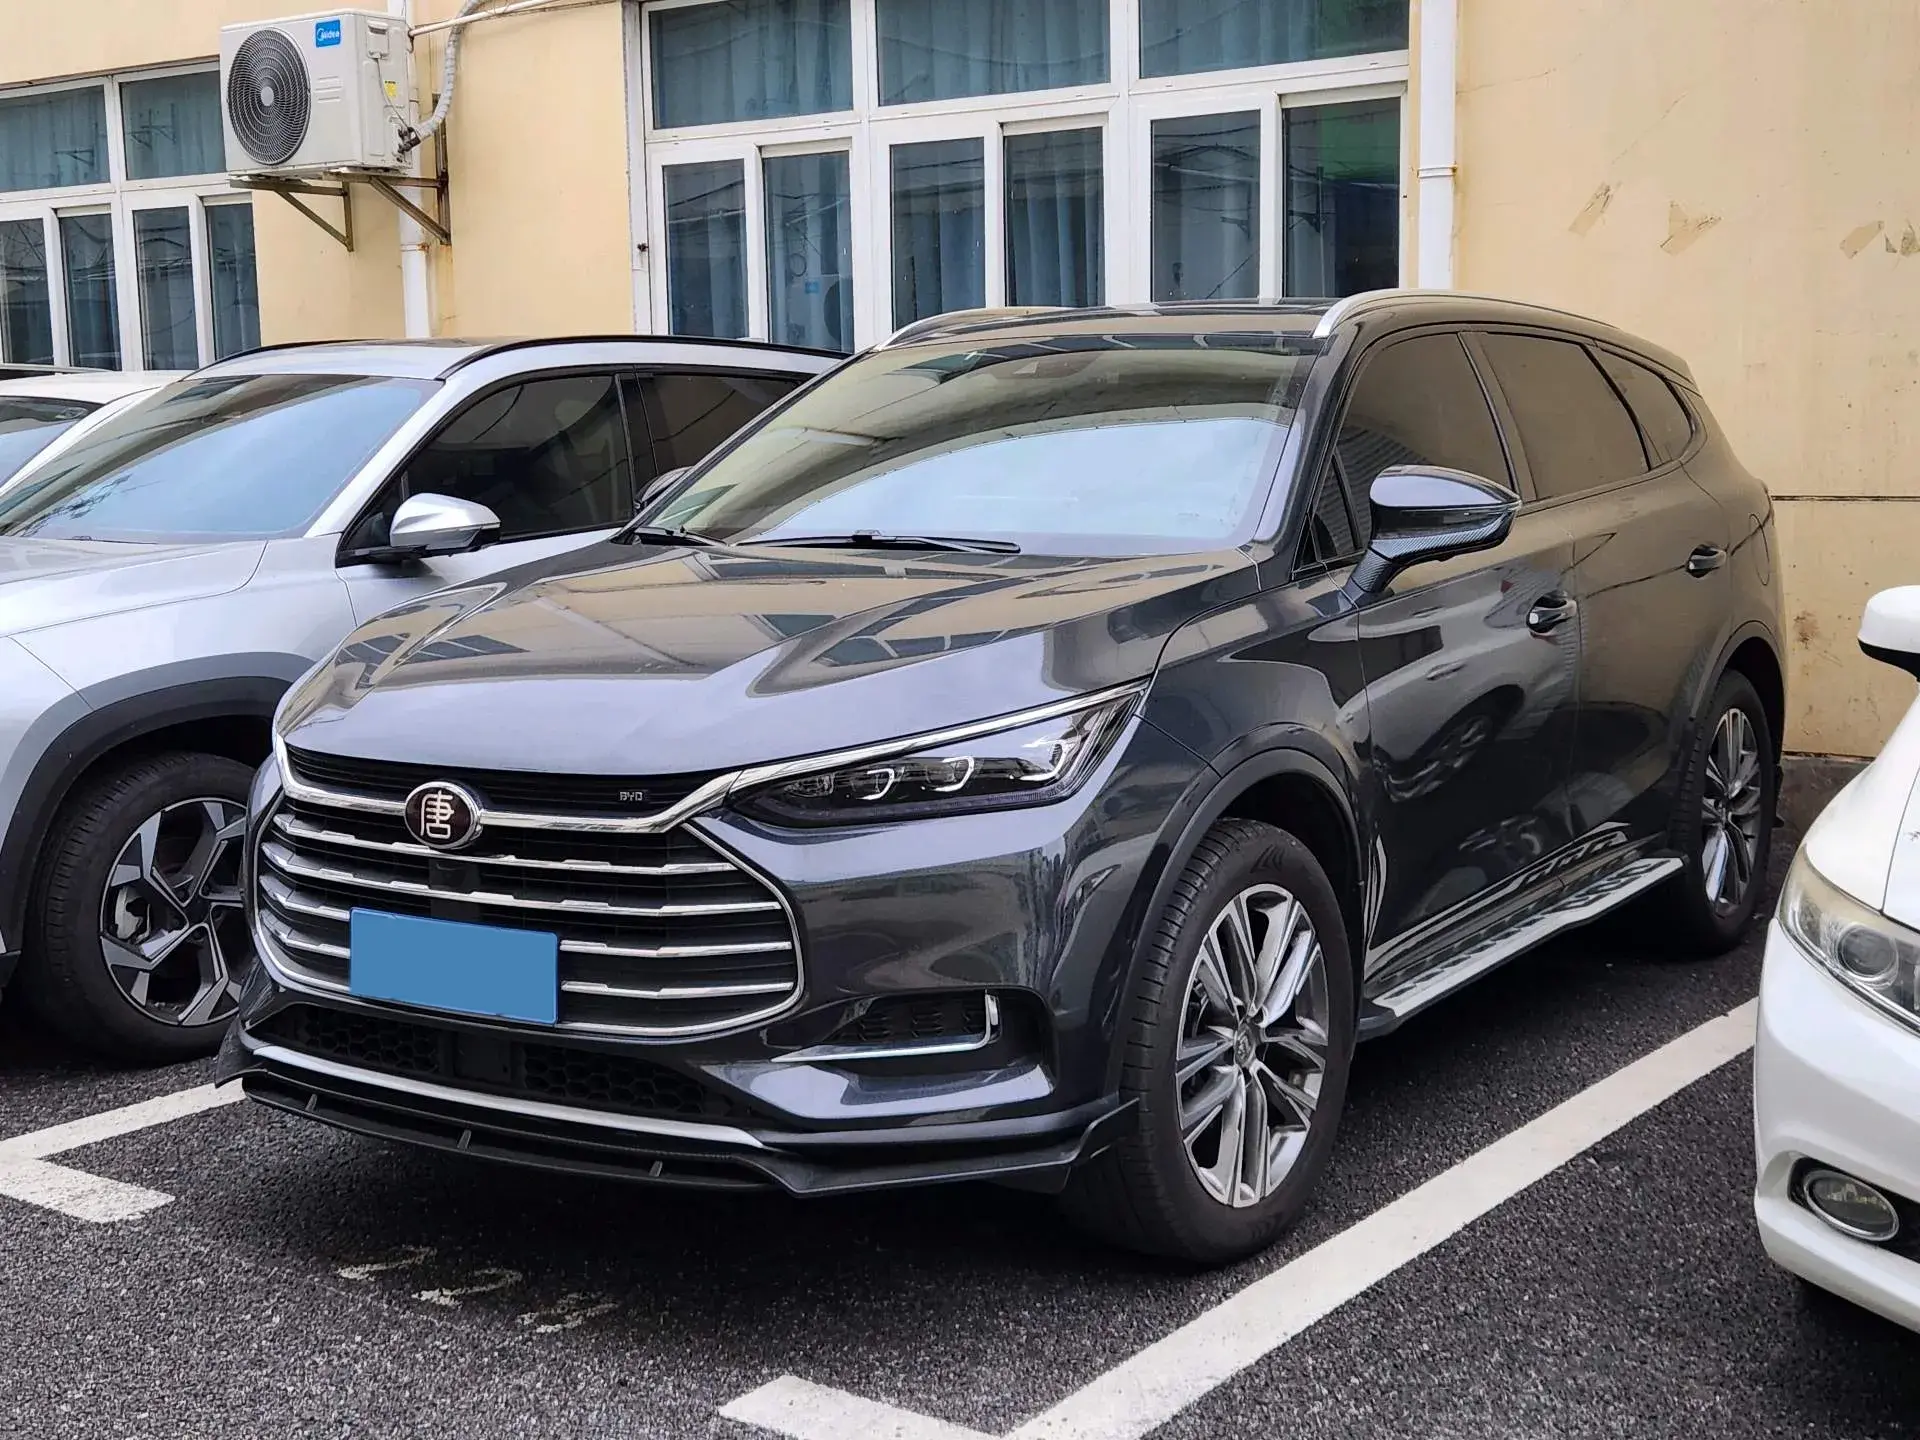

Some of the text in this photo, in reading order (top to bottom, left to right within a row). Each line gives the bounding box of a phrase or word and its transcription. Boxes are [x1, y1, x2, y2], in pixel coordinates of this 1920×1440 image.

[316, 27, 340, 41] Midea
[619, 791, 643, 801] BYD
[420, 790, 454, 839] 唐
